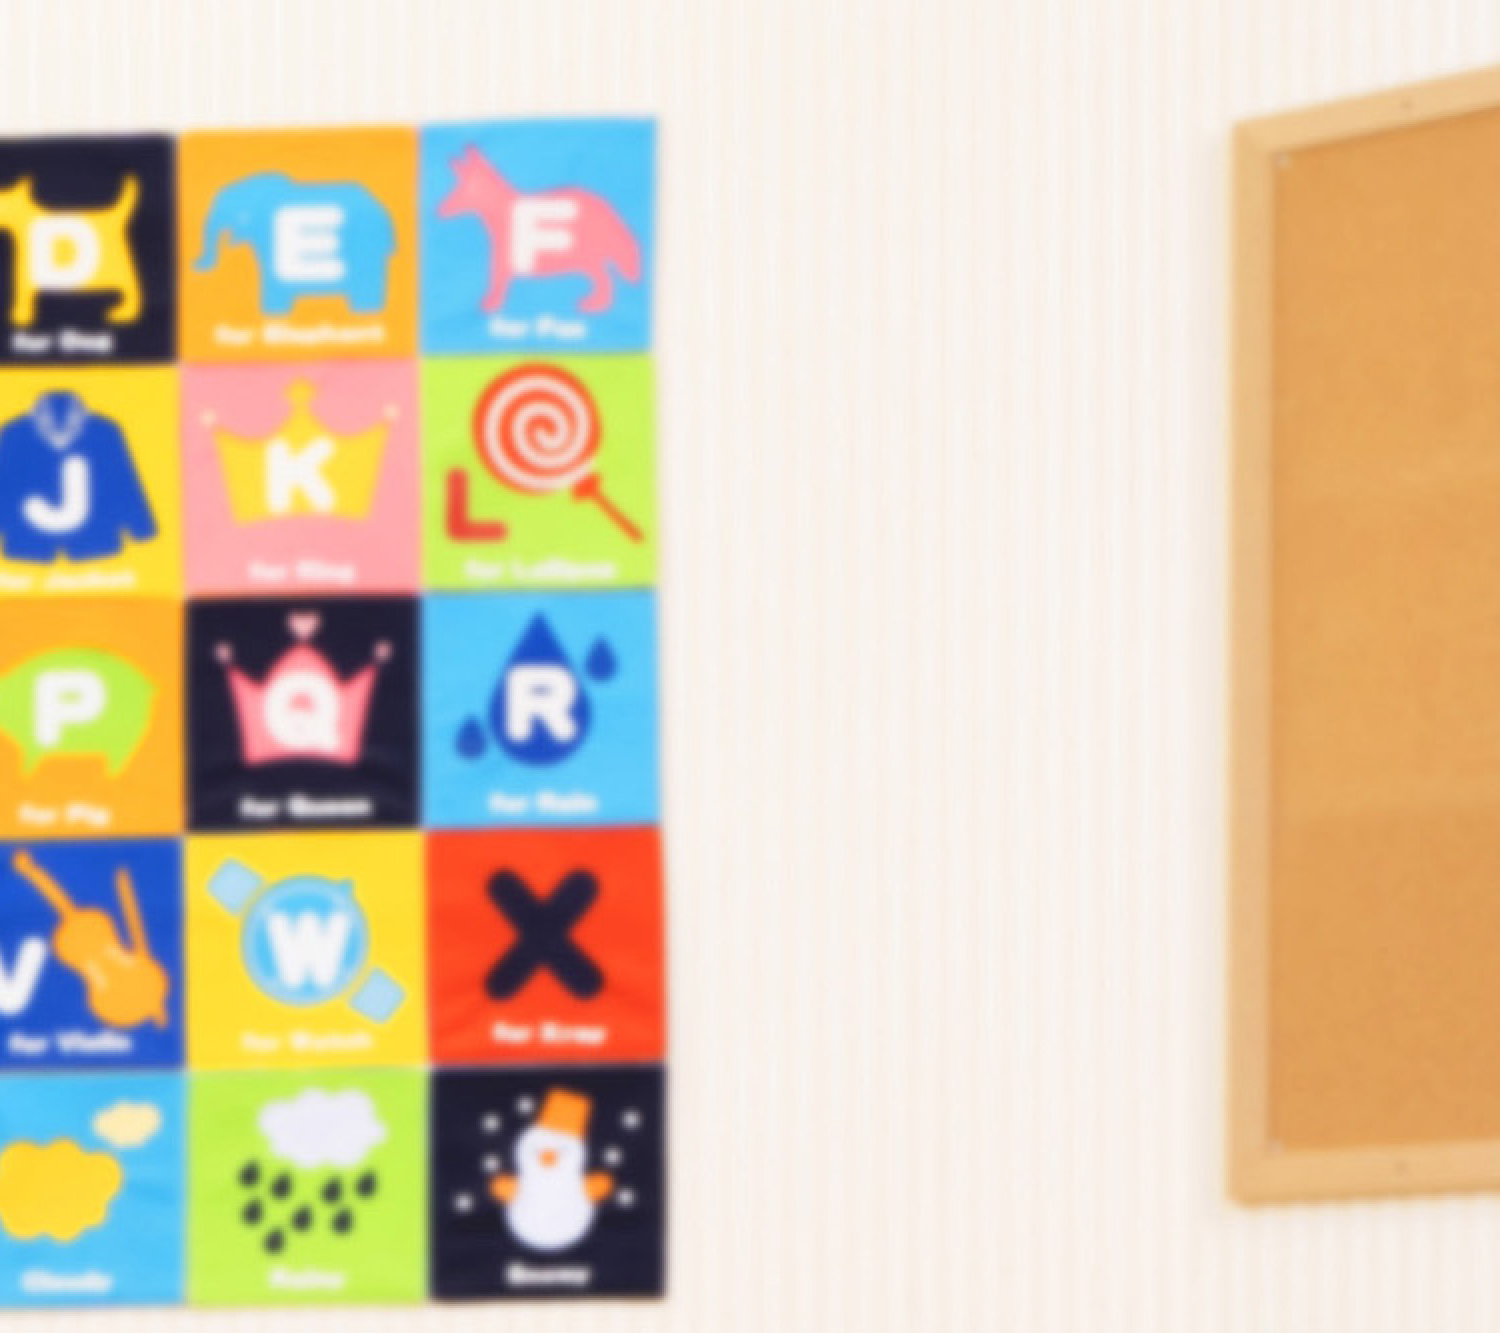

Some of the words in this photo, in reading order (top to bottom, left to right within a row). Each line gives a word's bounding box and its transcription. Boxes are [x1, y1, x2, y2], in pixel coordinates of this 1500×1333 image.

[28, 214, 100, 290] D
[274, 206, 342, 282] E
[510, 196, 578, 276] F
[24, 456, 90, 532] J
[268, 440, 332, 512] K
[444, 468, 508, 542] L
[34, 670, 108, 748] P
[262, 670, 342, 752] Q
[506, 664, 576, 740] R
[265, 907, 349, 989] W
[484, 868, 606, 1002] X
